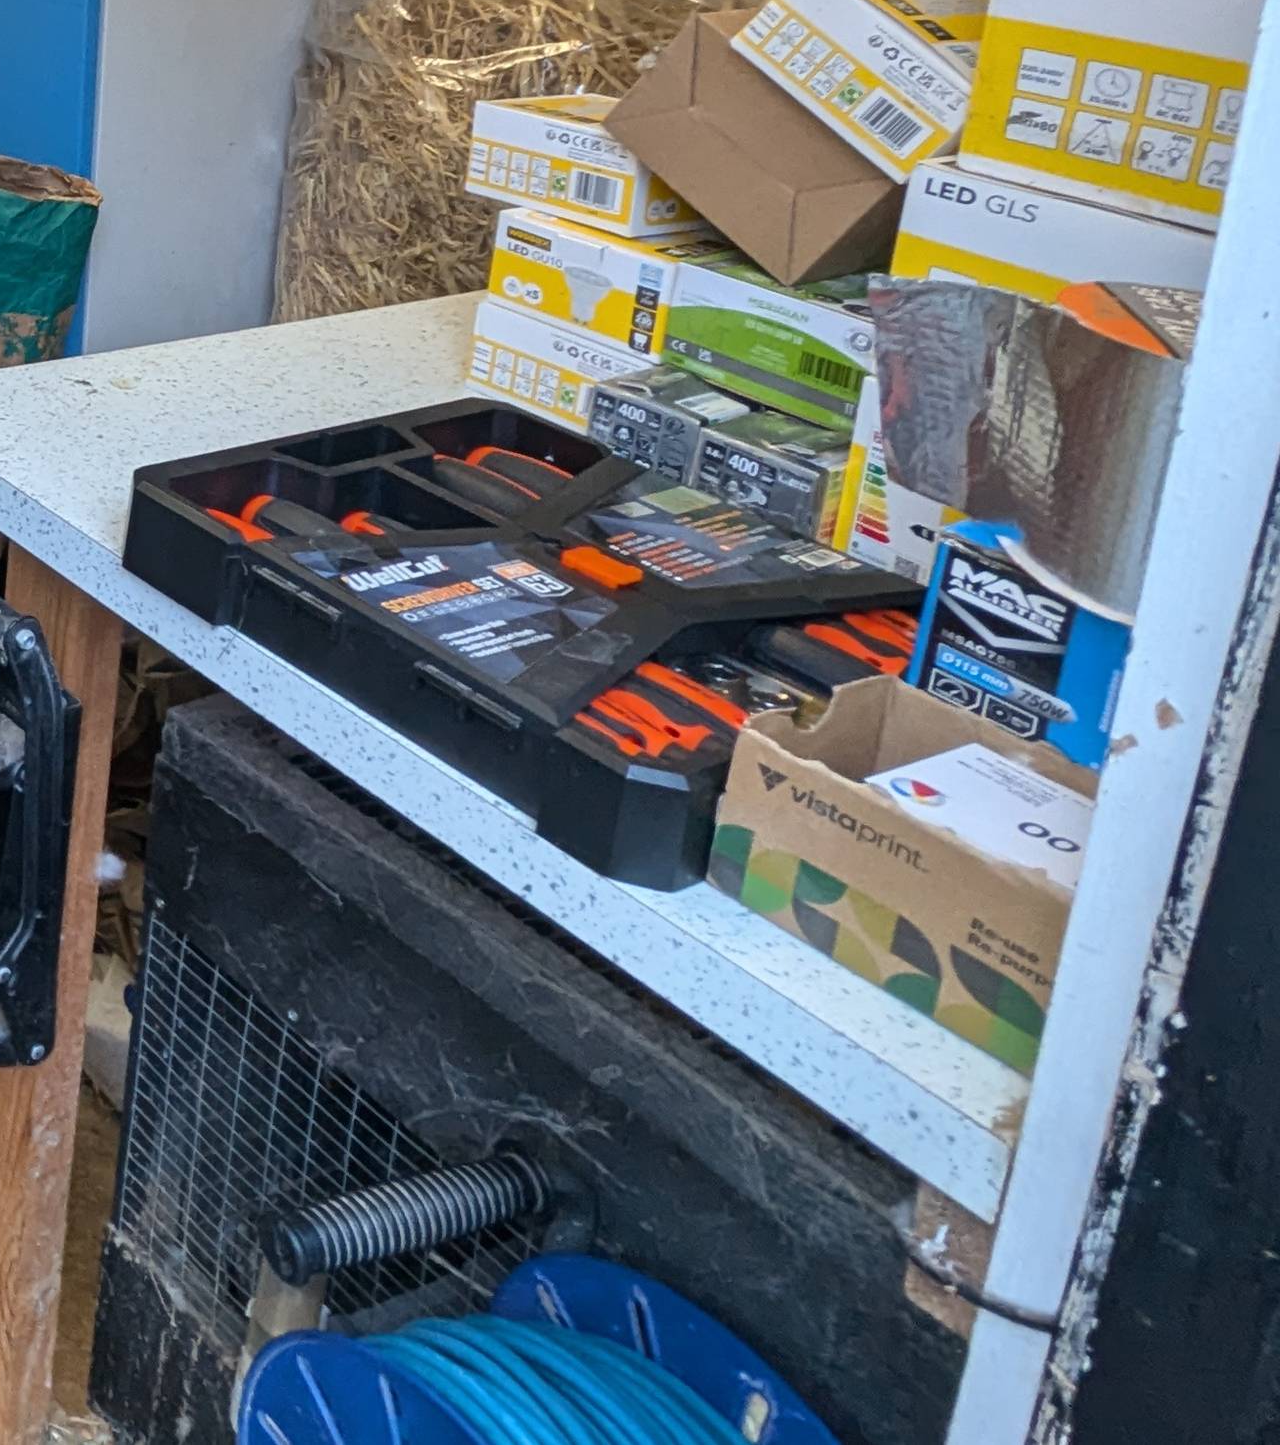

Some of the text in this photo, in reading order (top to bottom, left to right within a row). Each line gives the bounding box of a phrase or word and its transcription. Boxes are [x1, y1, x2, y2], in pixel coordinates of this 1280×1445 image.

[925, 177, 1040, 223] LED GLS
[507, 242, 529, 257] LED
[618, 405, 646, 423] 400
[728, 454, 759, 477] 400
[341, 554, 450, 593] WellCut
[518, 573, 566, 593] 63
[951, 557, 1067, 623] MAC
[1017, 688, 1070, 720] 750W
